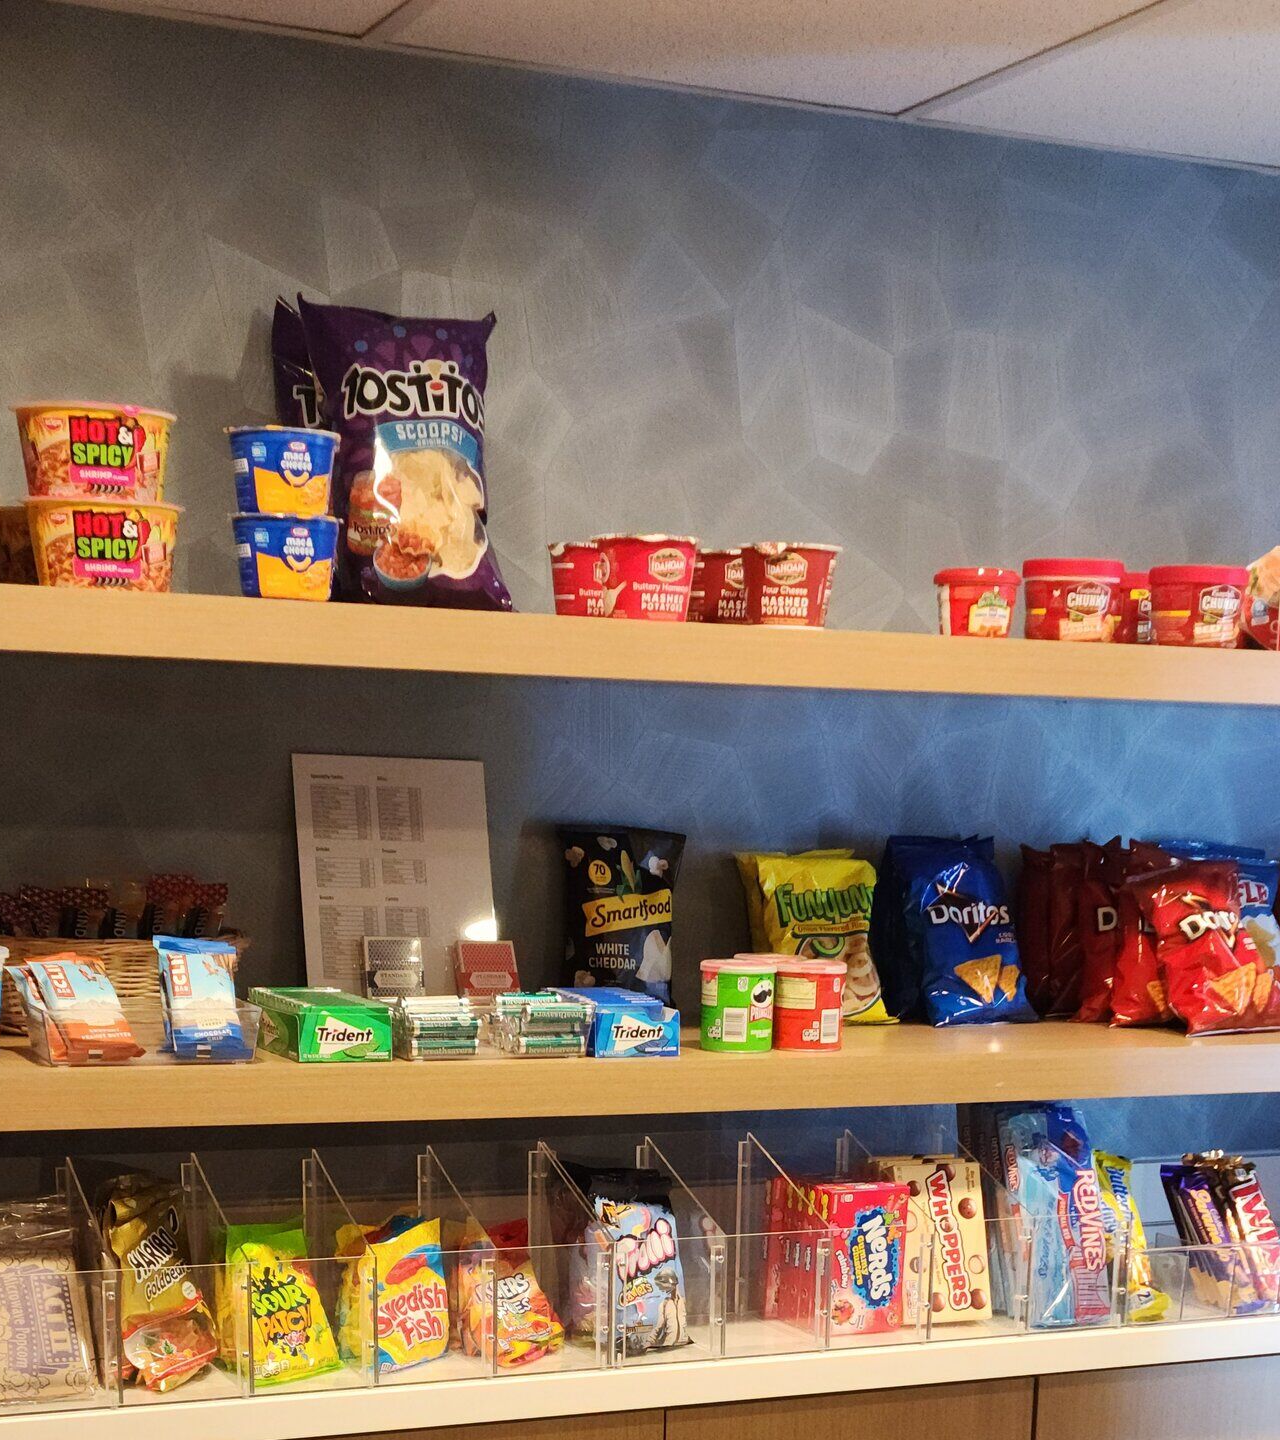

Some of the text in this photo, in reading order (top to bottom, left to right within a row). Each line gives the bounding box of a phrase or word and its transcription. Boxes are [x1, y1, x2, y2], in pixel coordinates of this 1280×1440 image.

[72, 416, 119, 445] HOT
[117, 426, 134, 446] &
[395, 422, 464, 446] SCOOPS!
[72, 443, 133, 468] SPICY
[75, 511, 139, 539] HOT &
[77, 535, 138, 560] SPICY
[641, 593, 684, 604] MASHED
[761, 596, 809, 607] MASHED
[1067, 592, 1109, 608] CHUNKY
[593, 862, 606, 876] 70
[591, 898, 672, 928] Smartfood
[927, 901, 1010, 926] Doritos
[595, 942, 630, 956] WHITE
[588, 956, 637, 970] CHEDDAR
[317, 1024, 375, 1043] Trident
[612, 1024, 664, 1041] Trident
[927, 1170, 973, 1310] WHOPPERS
[127, 1226, 180, 1283] HARIBO
[835, 1249, 849, 1290] rainbow
[253, 1284, 308, 1315] SOUR
[370, 1282, 448, 1338] Swedish
[256, 1305, 312, 1345] PATCH
[396, 1312, 446, 1350] Fish
[15, 1327, 31, 1368] Popcorn
